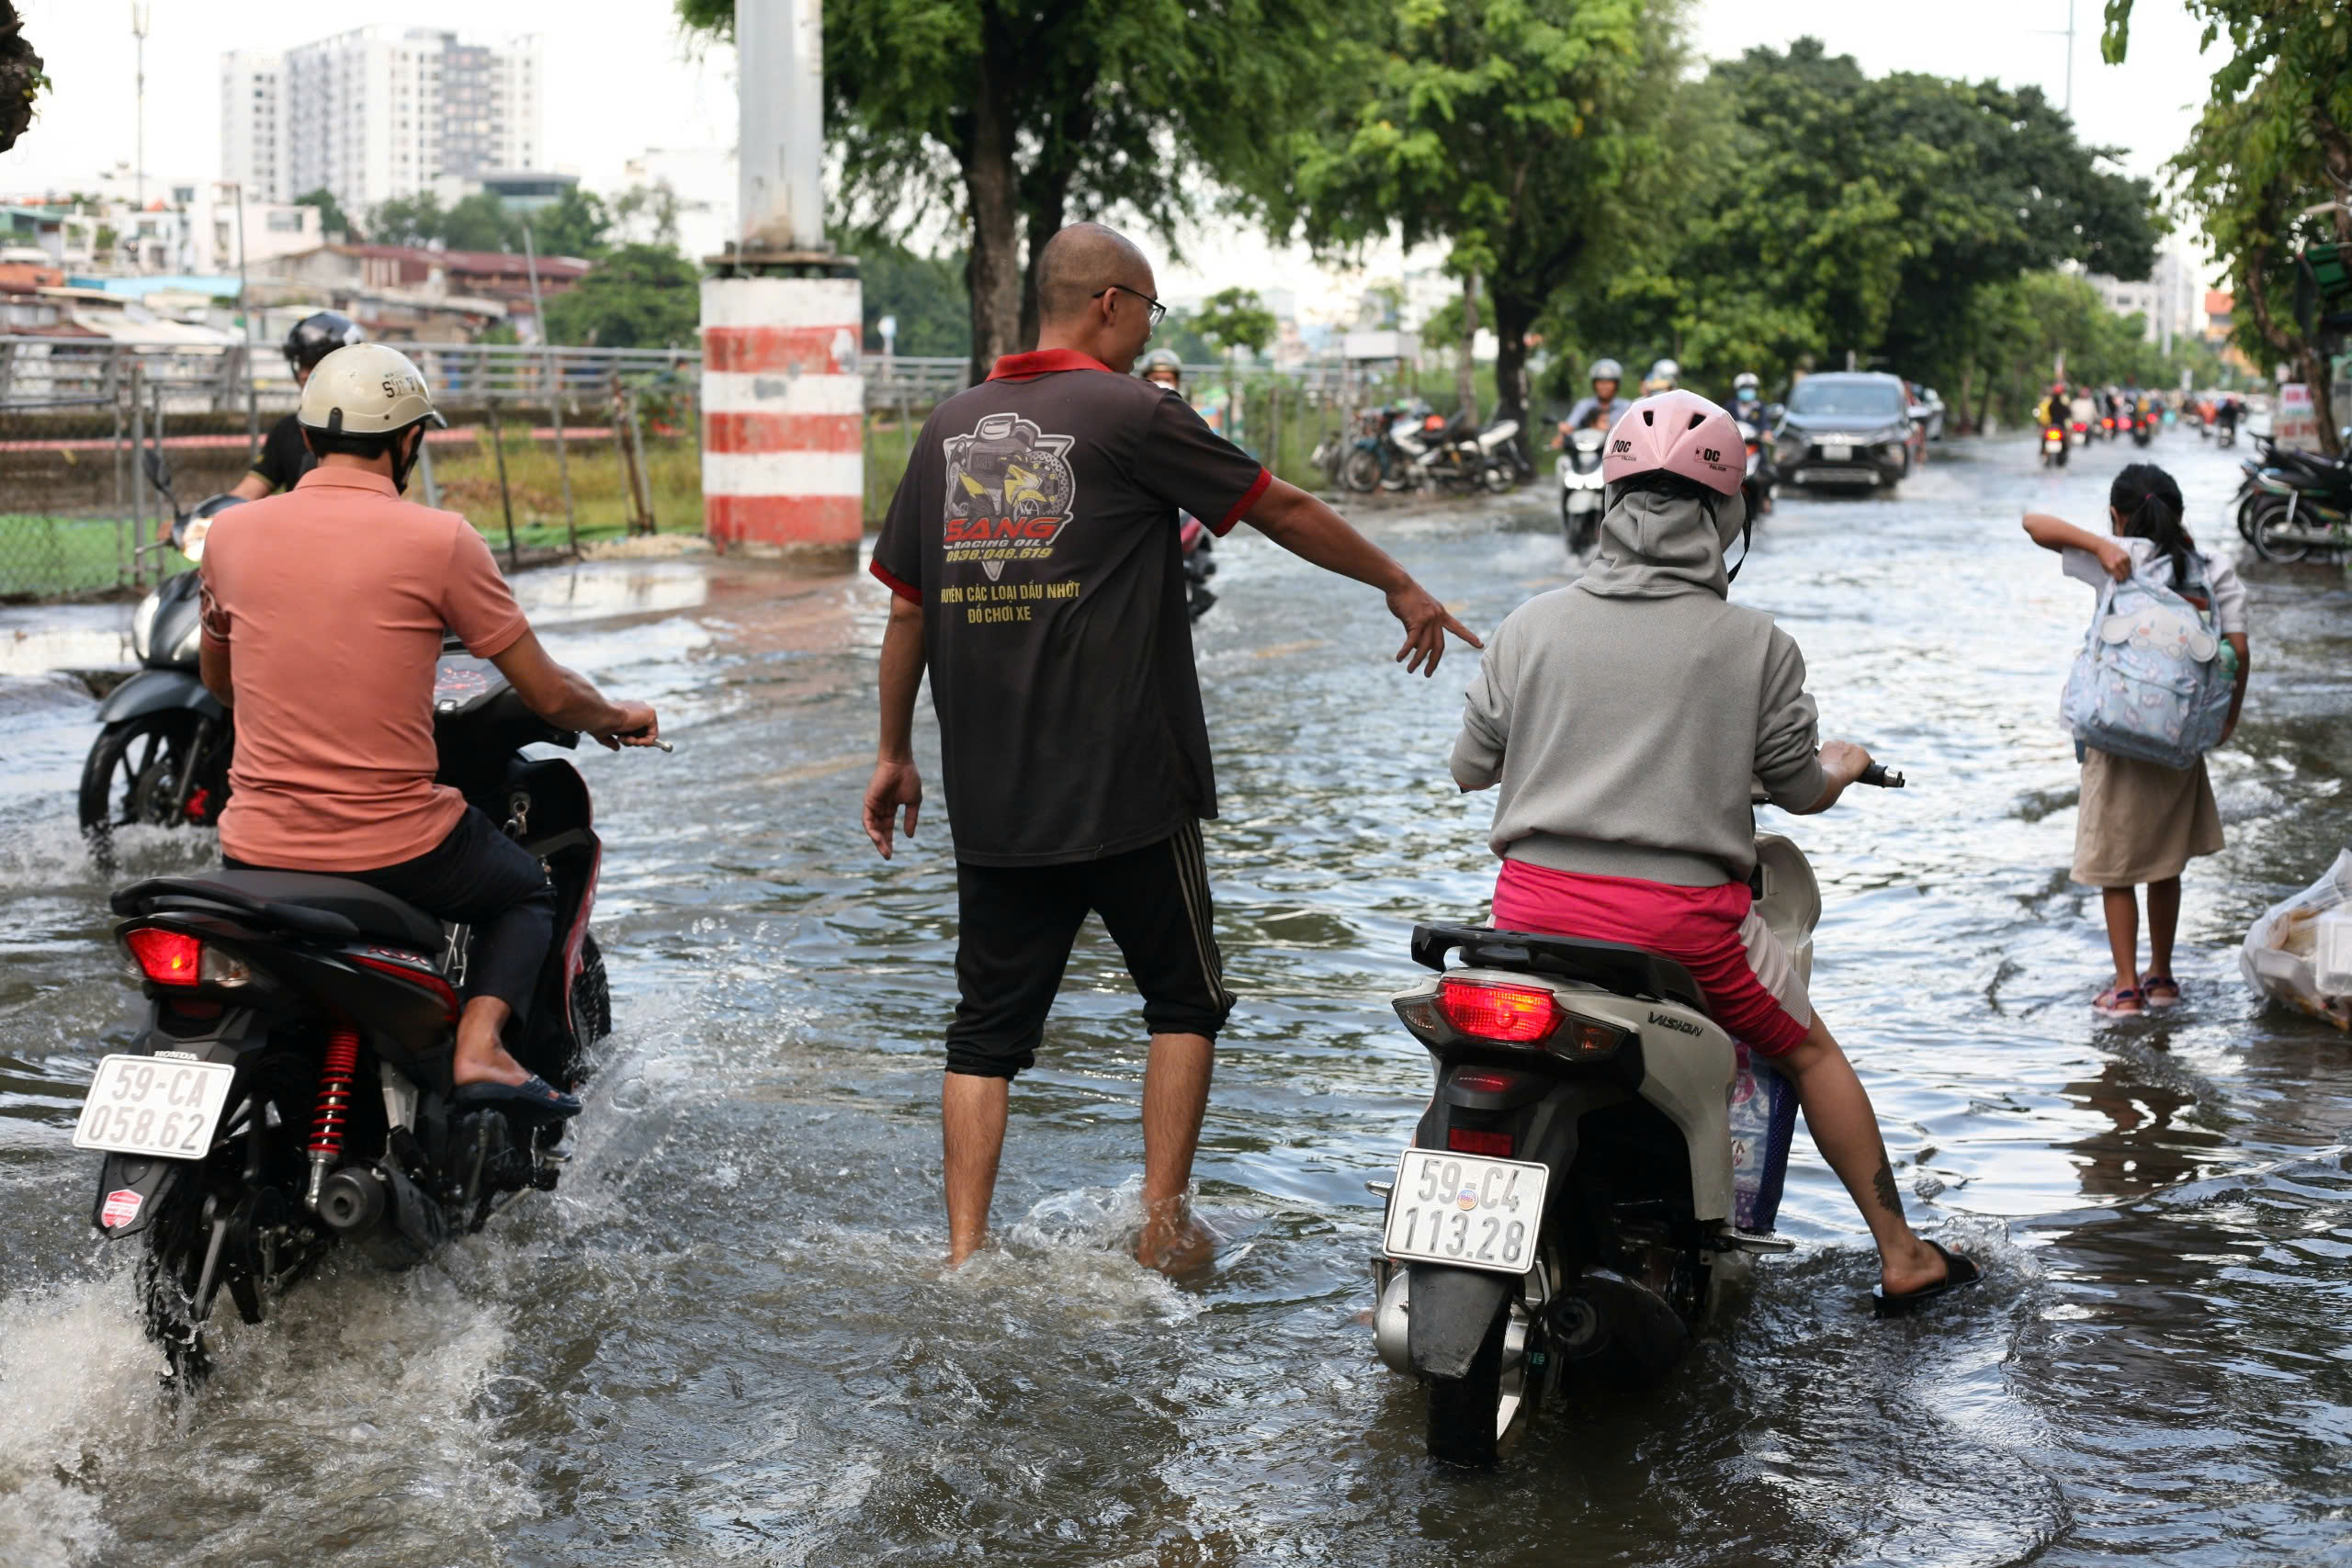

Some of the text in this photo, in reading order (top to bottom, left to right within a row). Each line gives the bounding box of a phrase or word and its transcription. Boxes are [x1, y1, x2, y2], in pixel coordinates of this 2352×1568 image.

[1709, 463, 1727, 472] FALCON
[944, 516, 1063, 542] SANG
[954, 538, 1042, 549] RACING OIL
[967, 583, 988, 602] CÁC
[984, 605, 1013, 624] CHƠI
[1016, 606, 1032, 621] XE
[1647, 1010, 1703, 1037] VISION
[154, 1050, 199, 1061] HONDA
[112, 1064, 209, 1108] 59-CA
[1459, 1076, 1504, 1086] HONDA
[88, 1105, 205, 1151] 058.62
[1418, 1157, 1521, 1213] 59-C4
[1405, 1206, 1526, 1265] 113.28
